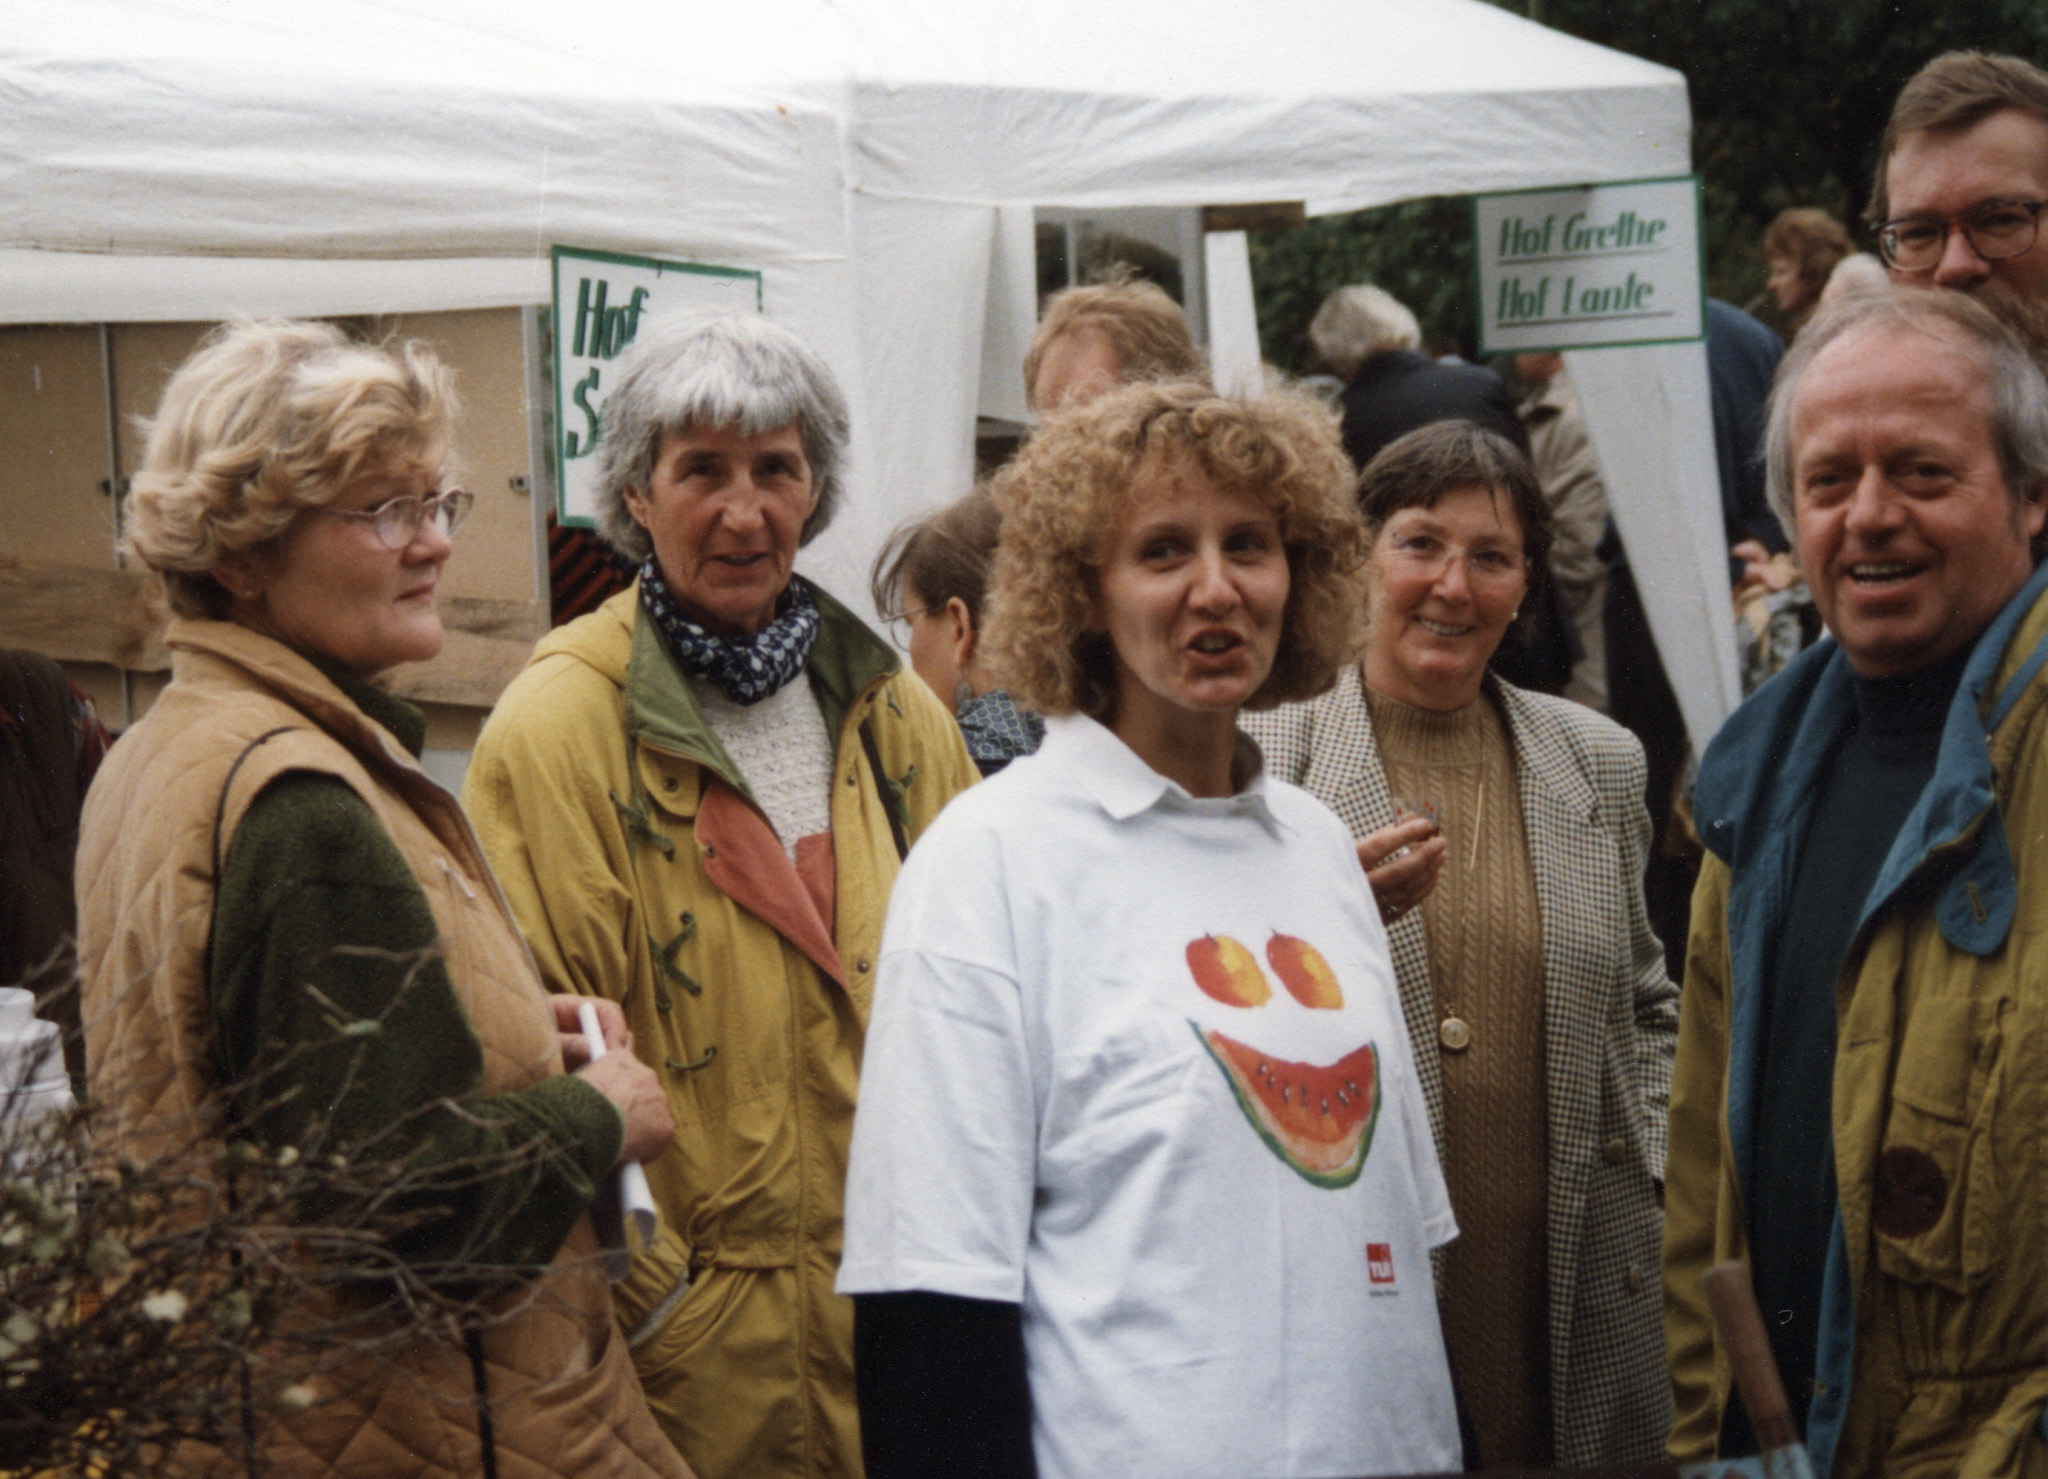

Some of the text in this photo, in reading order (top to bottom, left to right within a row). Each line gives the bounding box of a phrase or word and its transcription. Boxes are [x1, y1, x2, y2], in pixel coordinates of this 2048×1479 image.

[1499, 213, 1554, 256] Hof
[572, 276, 650, 361] Hof
[1498, 275, 1550, 320] Hof
[565, 365, 608, 461] S
